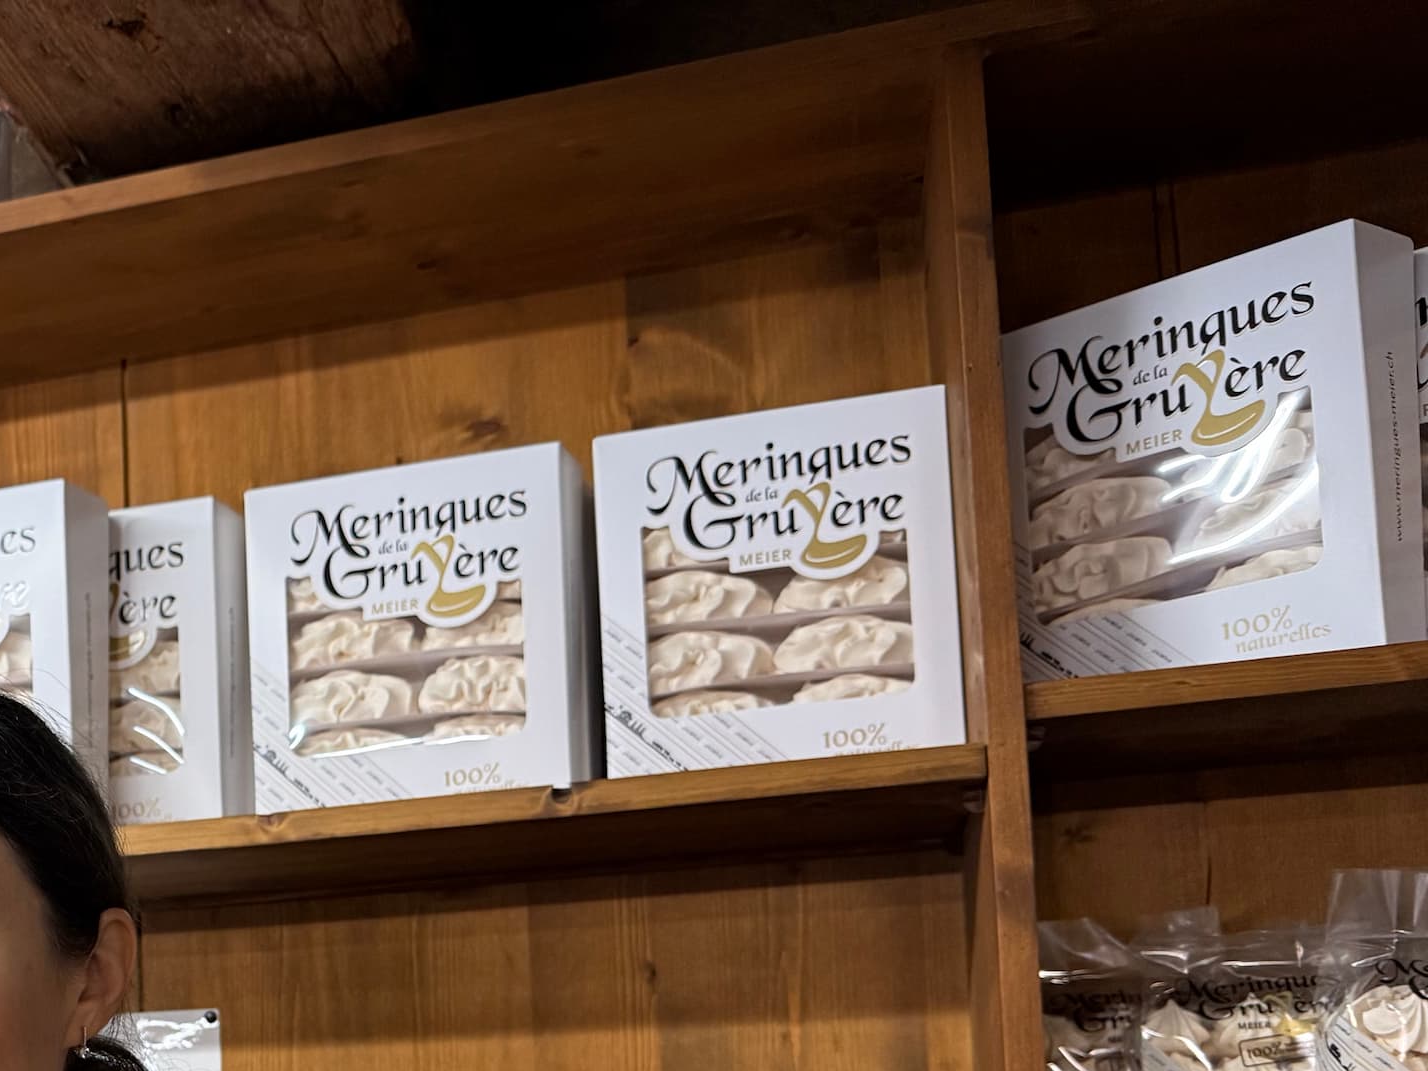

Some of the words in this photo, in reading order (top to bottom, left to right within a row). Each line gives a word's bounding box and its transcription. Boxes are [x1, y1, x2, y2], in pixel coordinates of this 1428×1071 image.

[1028, 281, 1315, 415] Meringues
[1133, 369, 1150, 386] de
[1153, 364, 1168, 381] la
[1126, 428, 1183, 456] MEIER
[1385, 351, 1404, 542] www.meringues-meier.ch
[647, 434, 912, 515] Meringues
[745, 488, 762, 502] de
[764, 487, 778, 500] la
[290, 489, 527, 566] Meringues
[378, 543, 392, 555] de
[395, 541, 408, 552] la
[739, 548, 792, 567] MEIER
[371, 598, 419, 615] MEIER
[1220, 603, 1294, 642] 100%
[1235, 621, 1332, 654] naturelles
[822, 722, 888, 749] 100%
[444, 762, 501, 788] 100%
